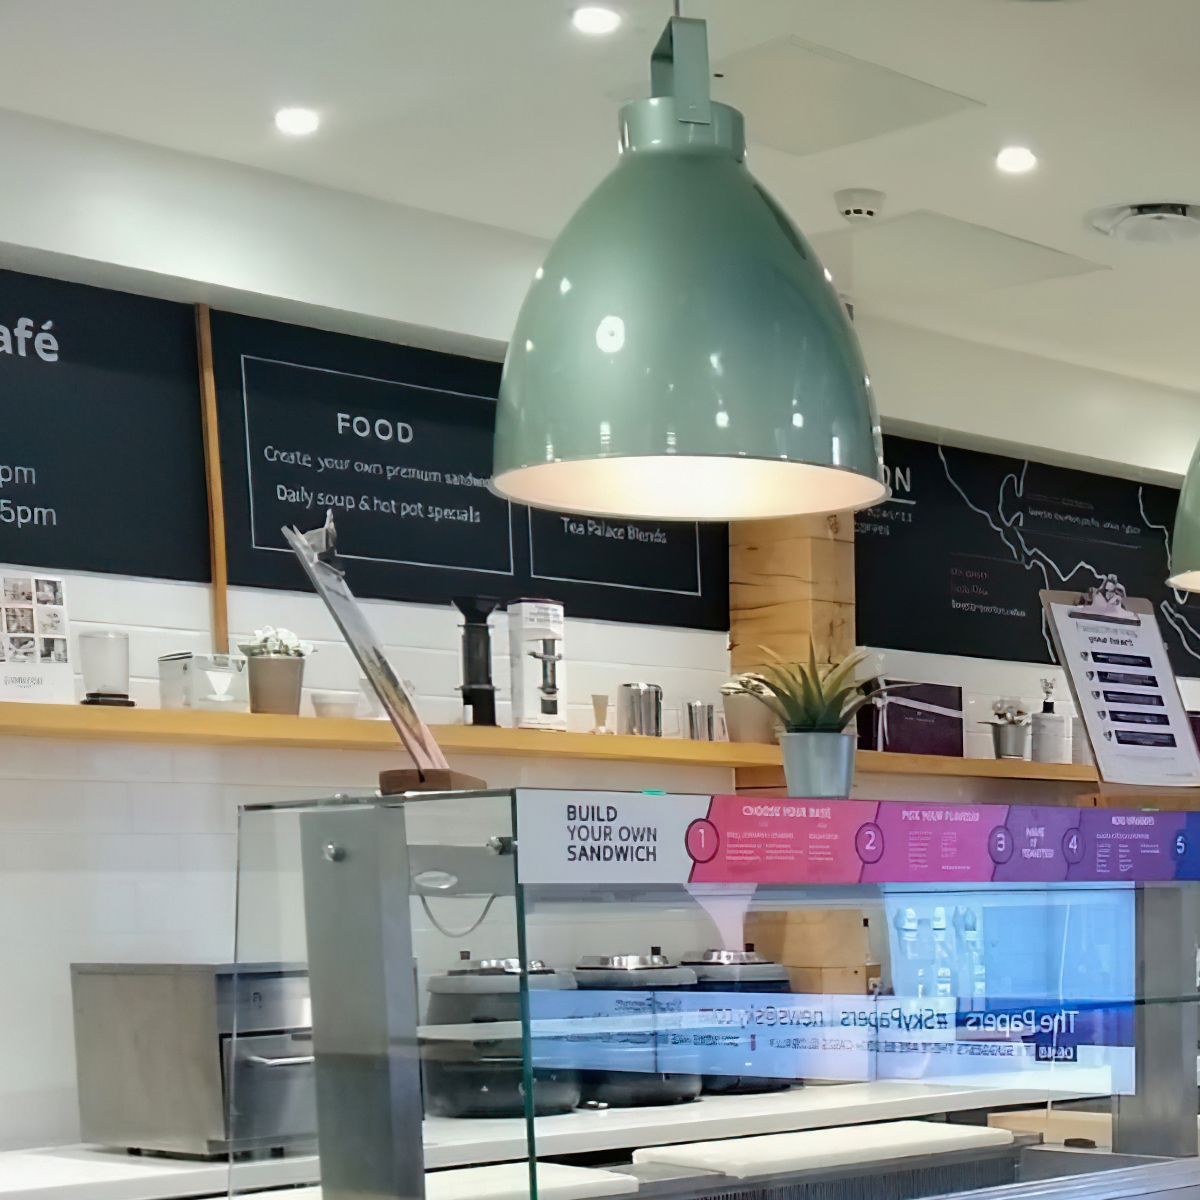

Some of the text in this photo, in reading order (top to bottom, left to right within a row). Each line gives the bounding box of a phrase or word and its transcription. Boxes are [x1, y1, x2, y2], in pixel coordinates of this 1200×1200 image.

[336, 412, 414, 443] FOOD
[263, 445, 312, 467] Create
[316, 456, 350, 473] your
[276, 484, 481, 523] Daily soup & hot pot specials
[560, 516, 585, 535] Tea
[566, 804, 618, 822] BUILD
[566, 825, 657, 842] YOUR OWN
[698, 827, 705, 848] 1
[863, 830, 877, 851] 2
[996, 833, 1006, 852] 3
[1068, 834, 1078, 853] 4
[1176, 835, 1186, 854] 5
[566, 845, 657, 862] SANDWICH
